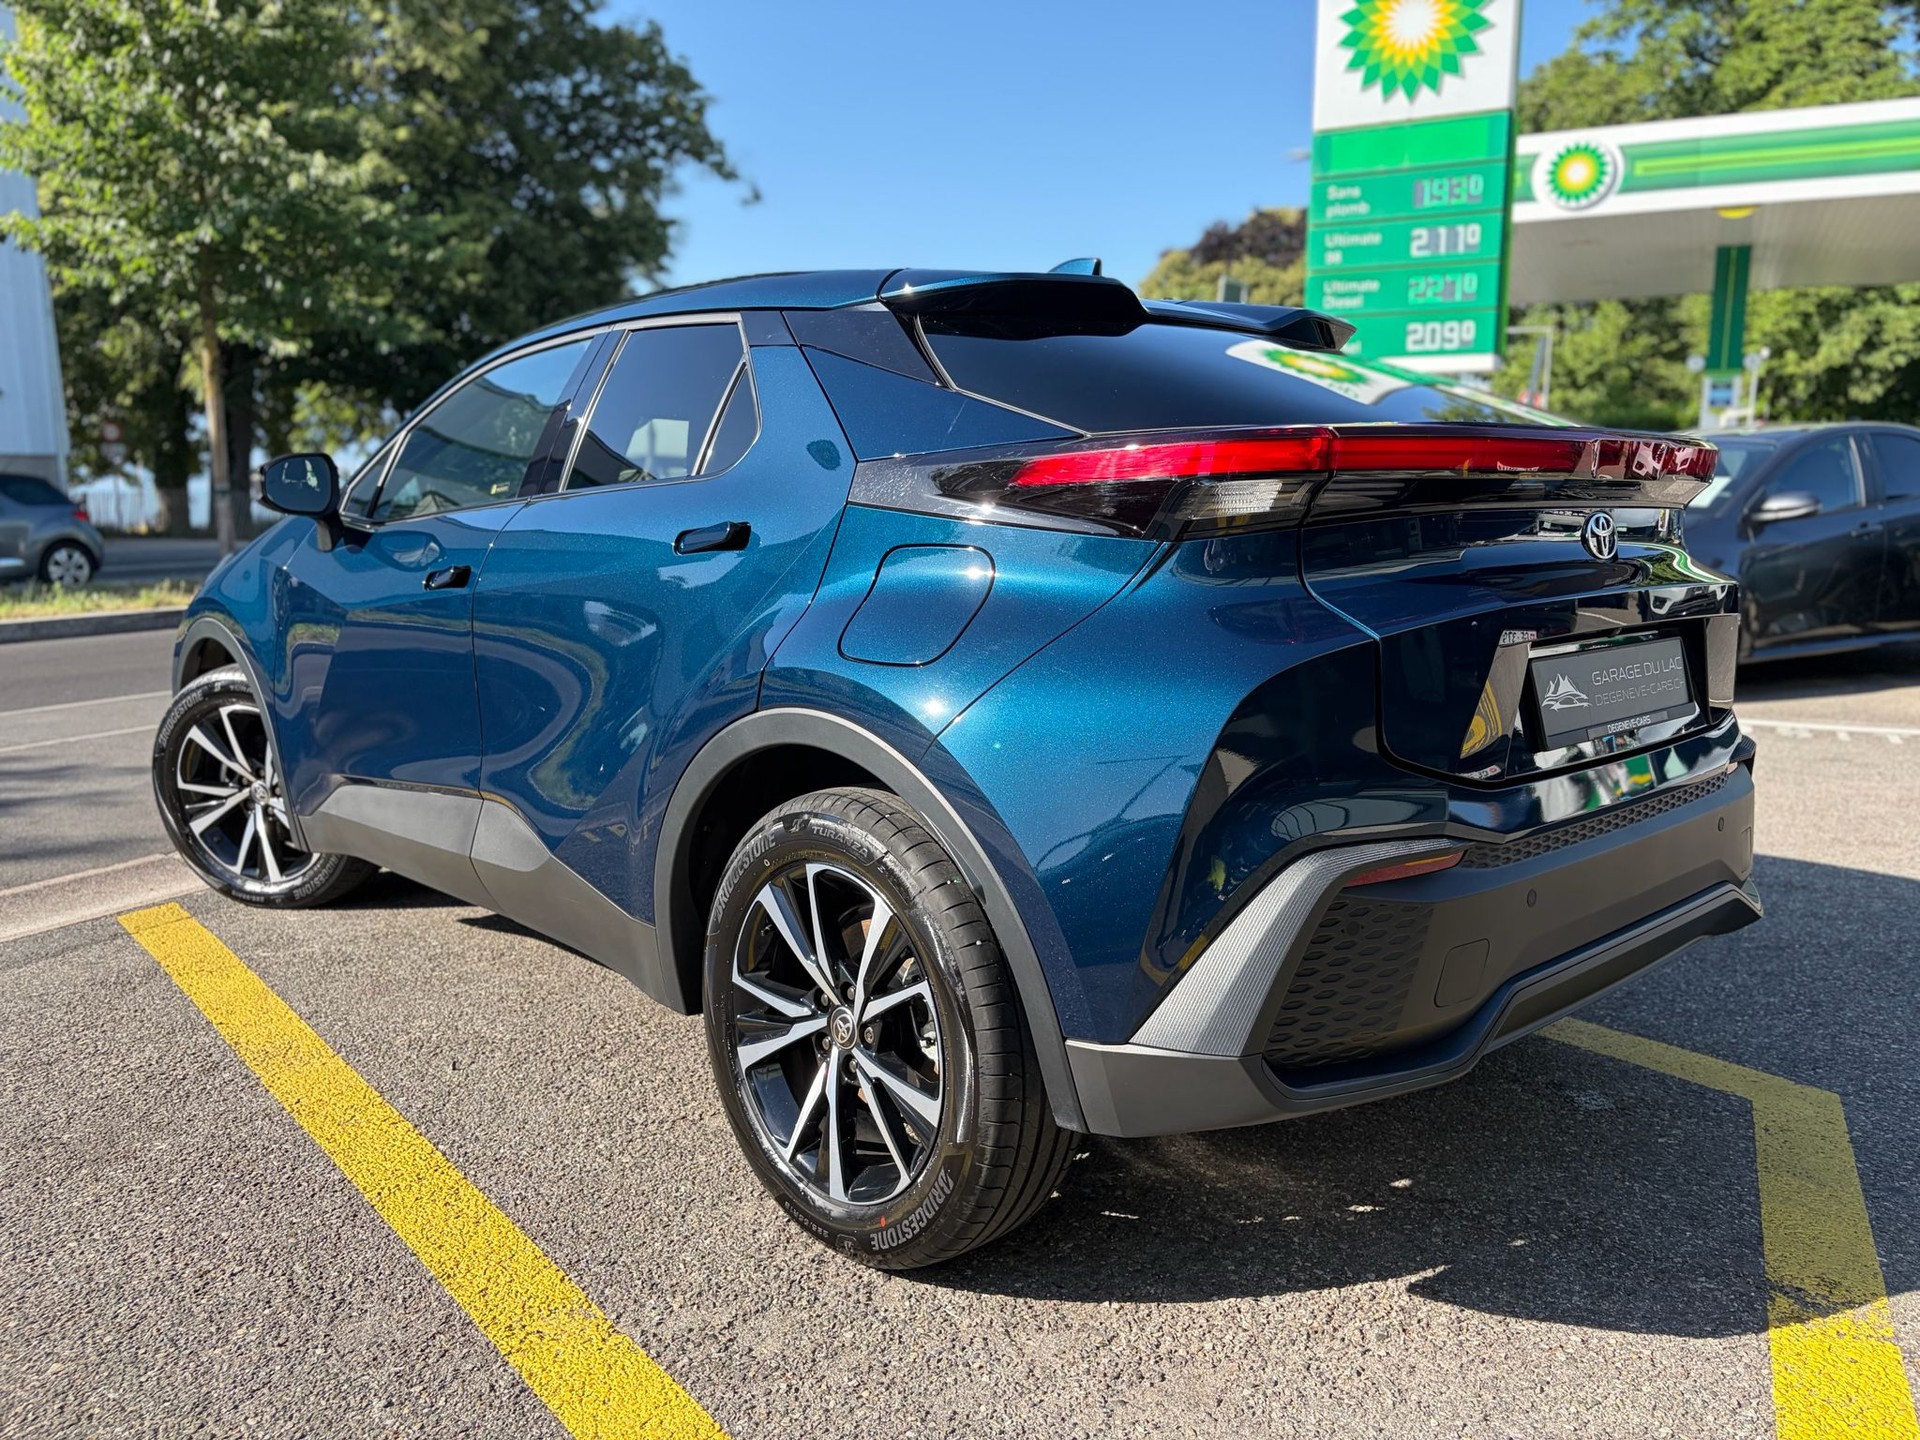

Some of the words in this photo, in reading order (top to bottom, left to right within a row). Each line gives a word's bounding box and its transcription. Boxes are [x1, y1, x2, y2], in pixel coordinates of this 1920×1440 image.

[1324, 232, 1382, 248] Ultimate
[1323, 280, 1380, 294] Ultimate
[1591, 663, 1642, 686] GARAGE
[1643, 660, 1661, 675] DU
[1662, 656, 1682, 671] LAC
[158, 689, 204, 748] BRIDGESTONE
[811, 825, 870, 858] TURANZA
[293, 854, 339, 900] RIDGESTONE
[713, 832, 777, 924] BRIDGESTONE
[869, 1164, 954, 1251] BRIDGESTONE
